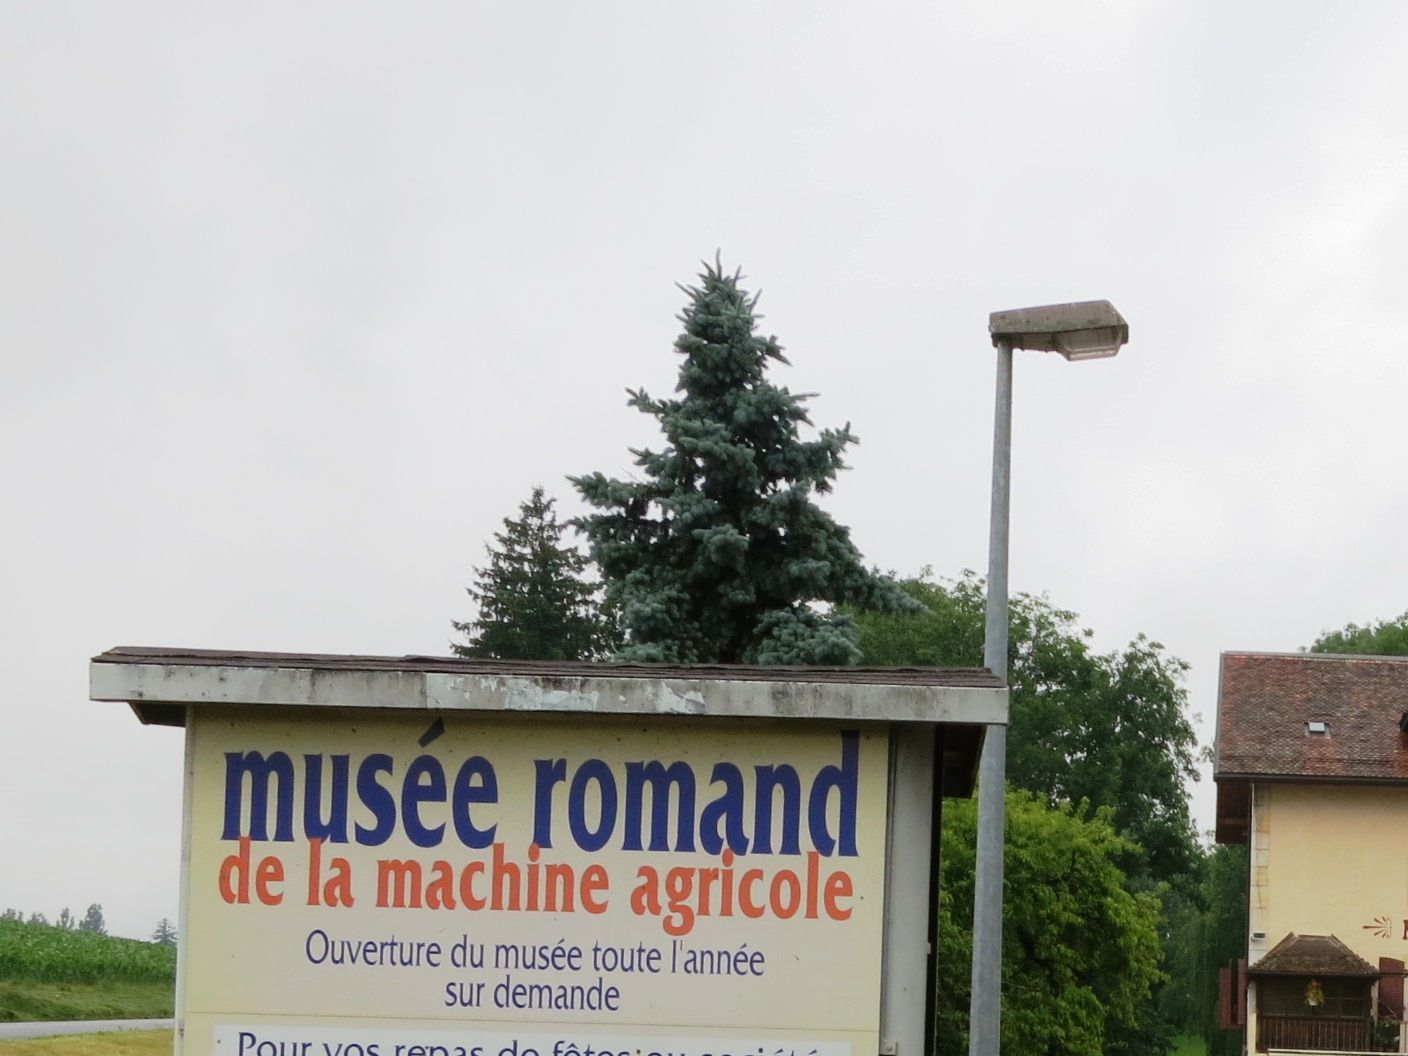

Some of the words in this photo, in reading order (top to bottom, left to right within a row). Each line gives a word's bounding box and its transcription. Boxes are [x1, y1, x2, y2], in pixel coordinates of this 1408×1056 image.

[221, 717, 498, 849] musée
[532, 730, 860, 857] romand
[219, 836, 284, 906] de
[306, 837, 355, 907] la
[375, 843, 609, 914] machine
[630, 848, 853, 936] agricole
[305, 929, 442, 967] Ouverture
[450, 934, 485, 968] du
[494, 938, 583, 970] musée
[592, 940, 662, 973] toute
[670, 940, 765, 976] l'année
[444, 981, 485, 1007] sur
[493, 974, 620, 1011] demande
